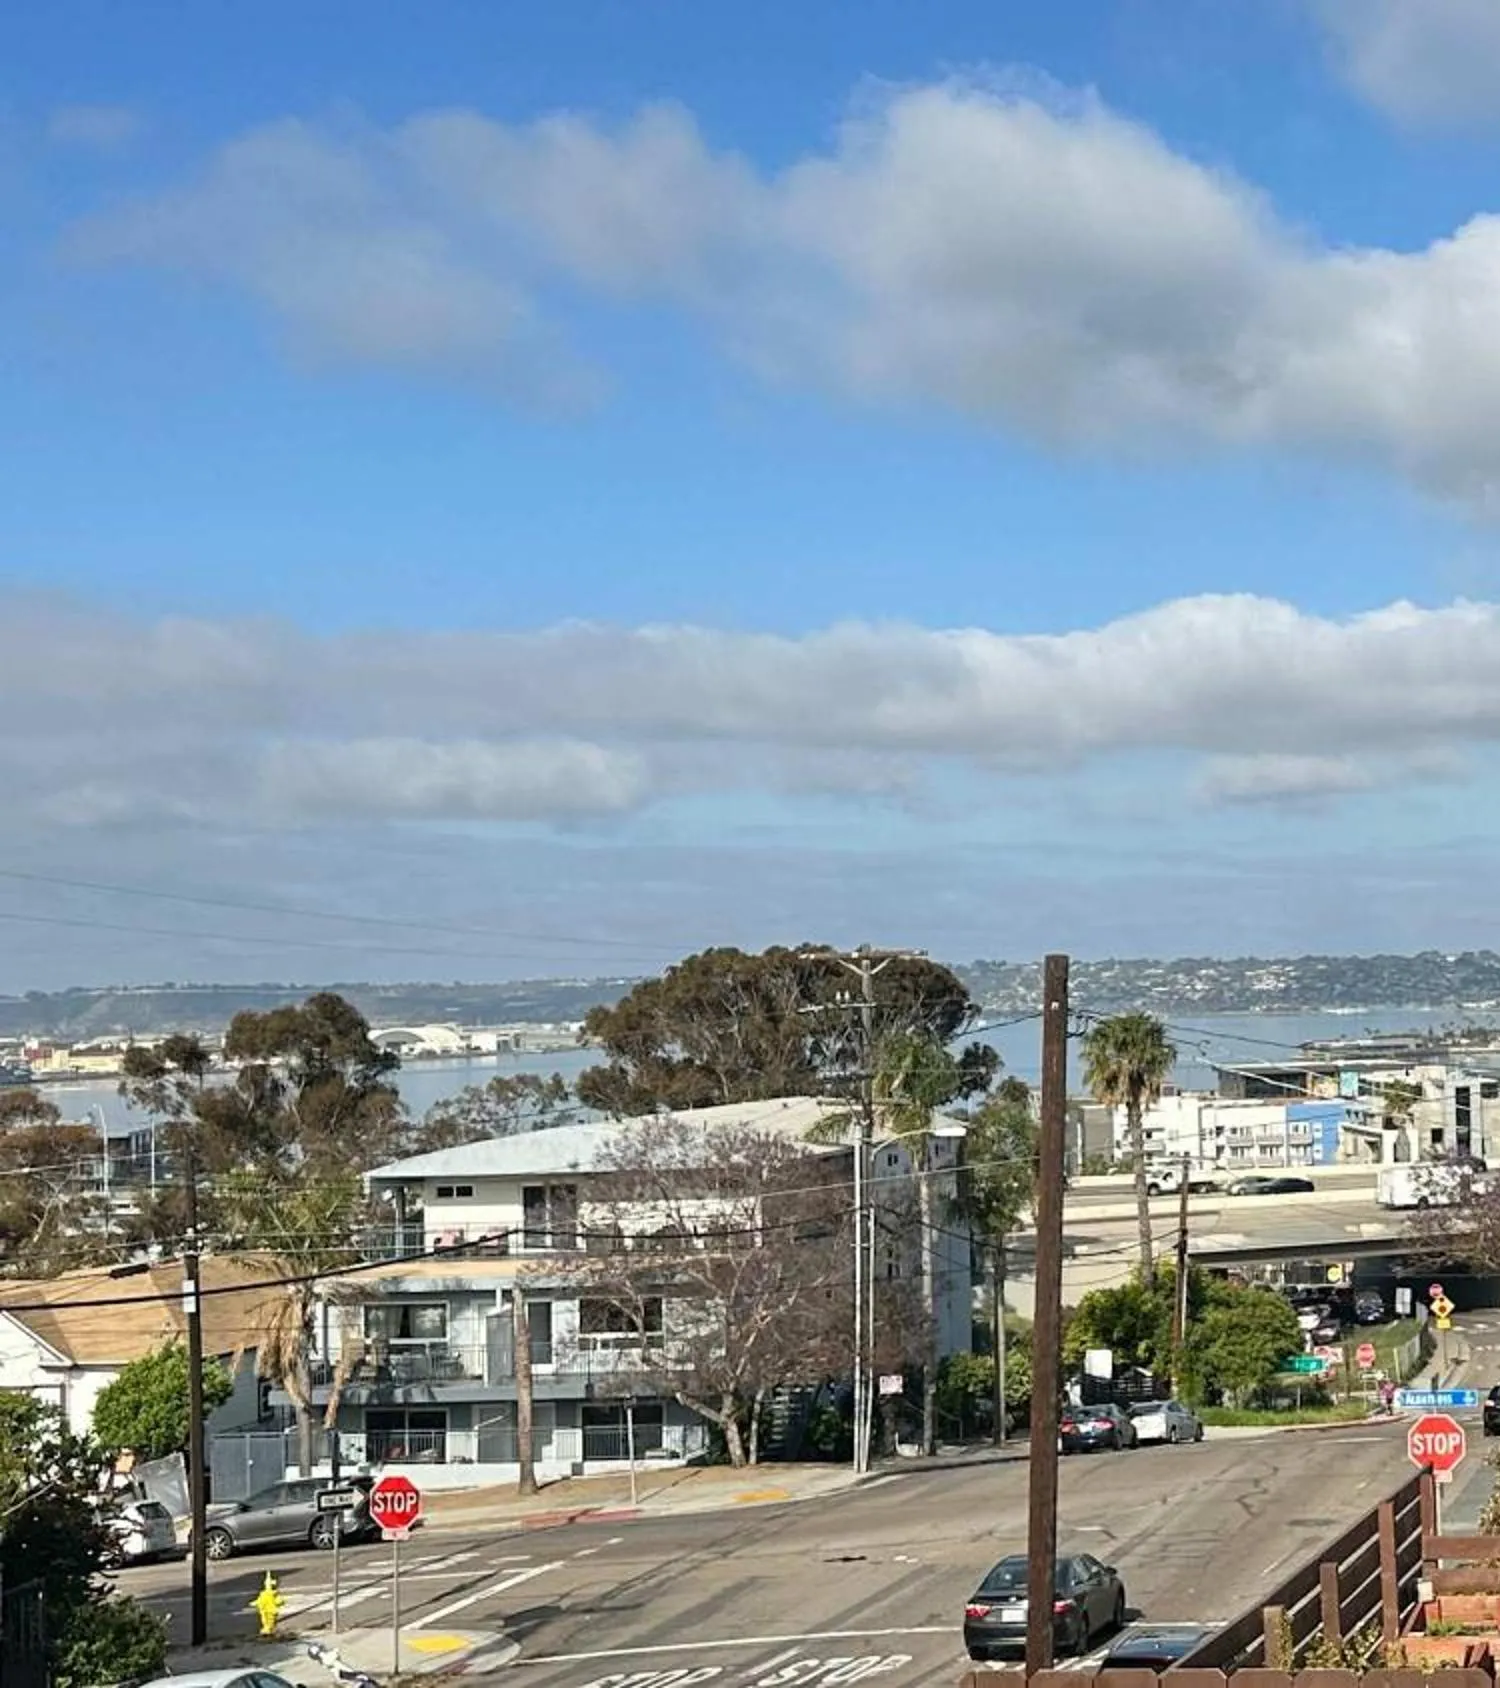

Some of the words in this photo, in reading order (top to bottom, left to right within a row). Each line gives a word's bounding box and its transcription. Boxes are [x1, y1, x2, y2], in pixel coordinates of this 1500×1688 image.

[1413, 1432, 1461, 1455] STOP
[373, 1491, 417, 1513] STOP
[757, 1654, 912, 1688] STOP
